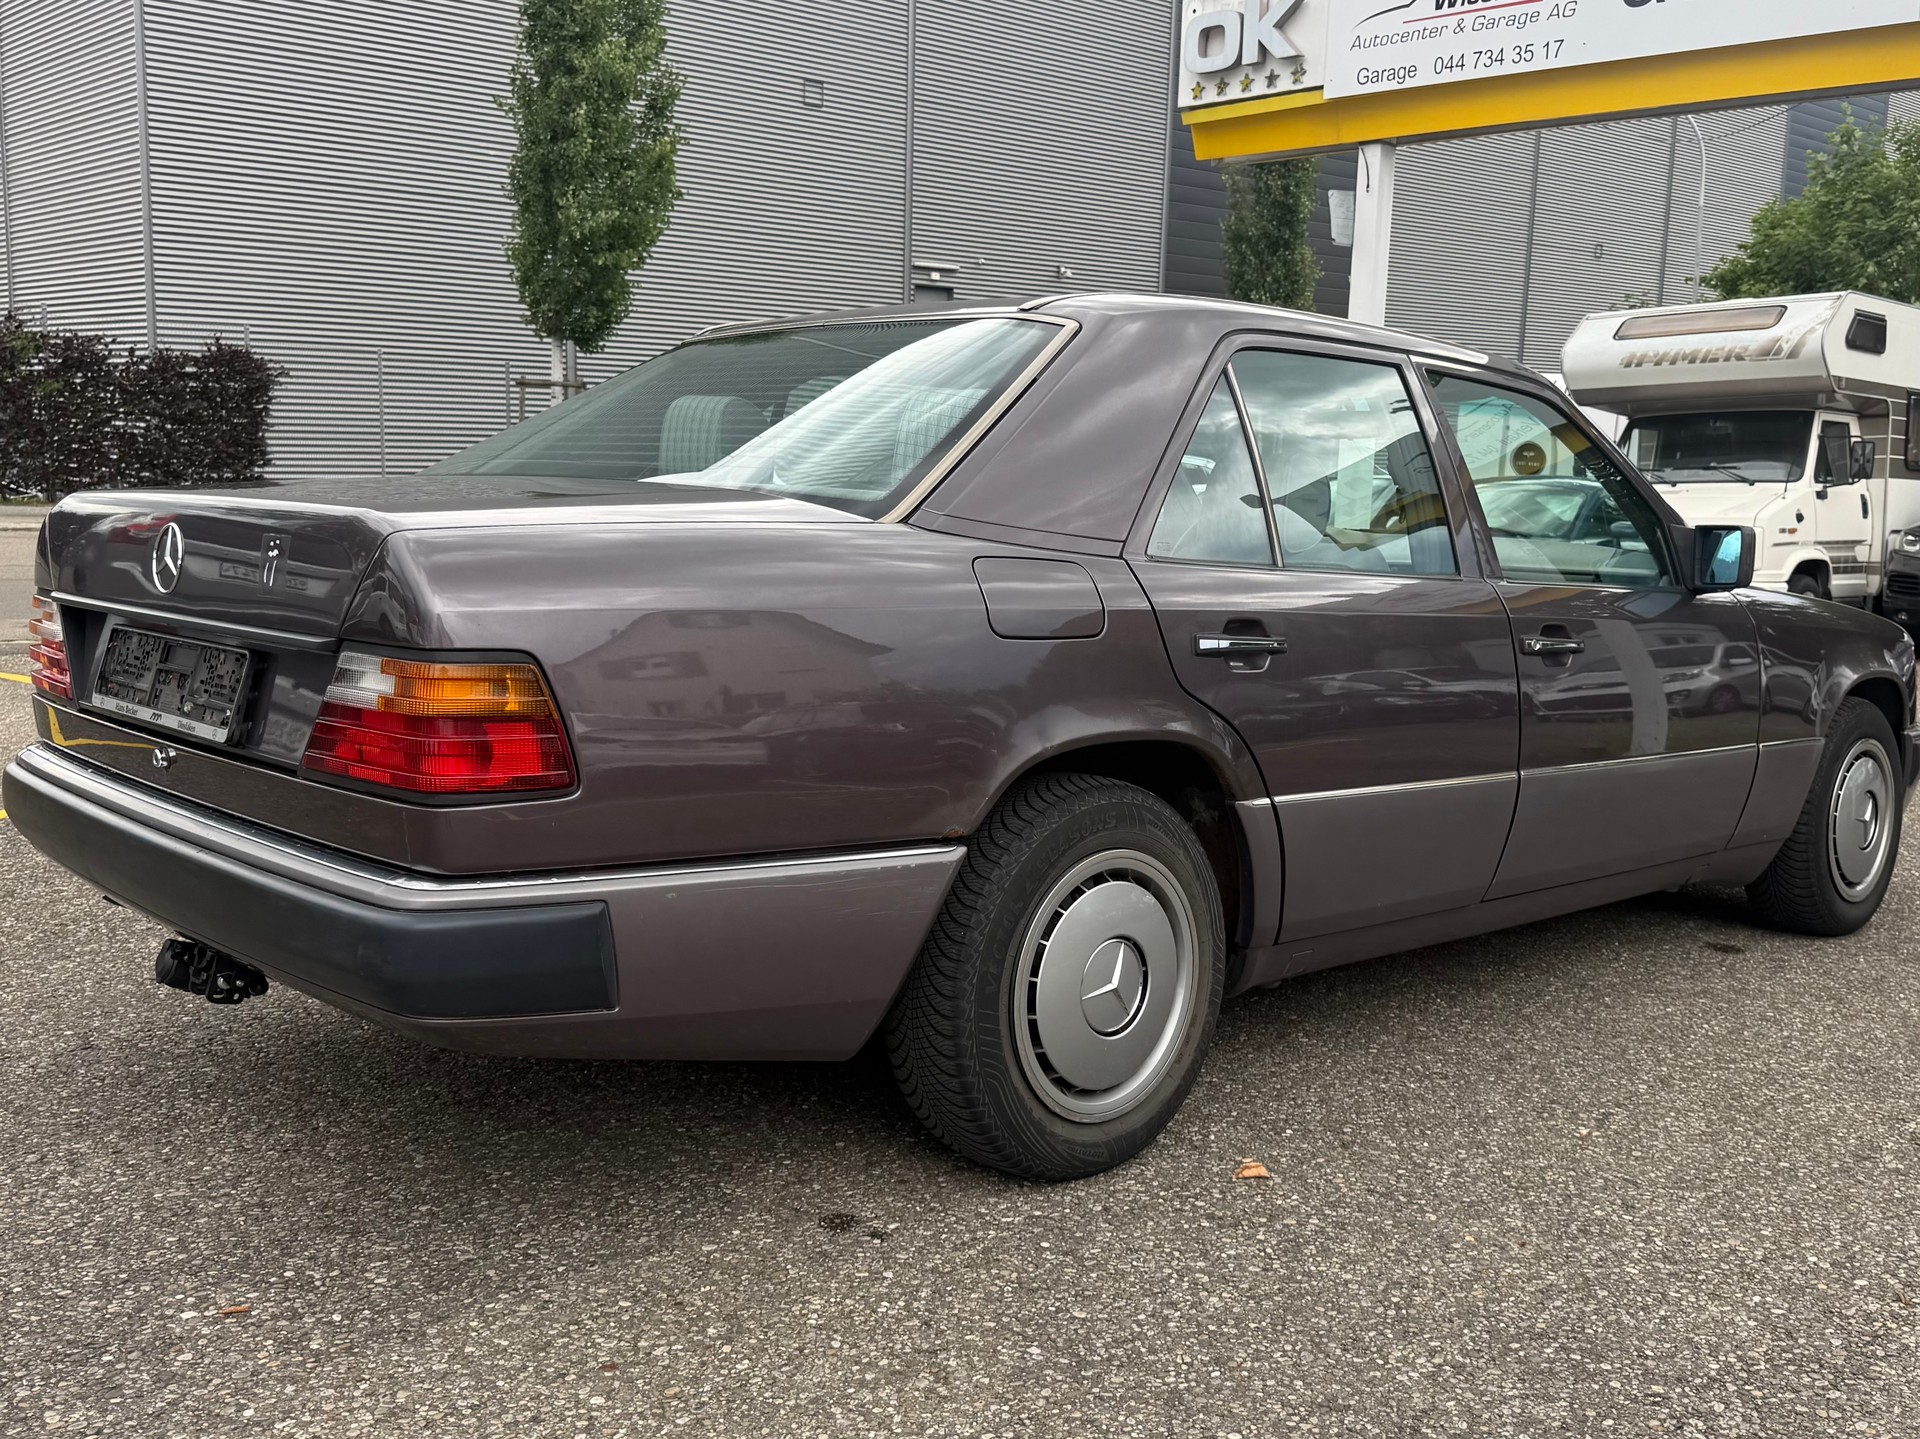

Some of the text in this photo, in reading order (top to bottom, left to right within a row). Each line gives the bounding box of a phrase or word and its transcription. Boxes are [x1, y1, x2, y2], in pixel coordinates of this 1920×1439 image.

[1350, 0, 1578, 51] Autocenter & Garage AG
[1356, 38, 1565, 86] Garage 044 734 35 17
[1621, 344, 1750, 369] HYMER
